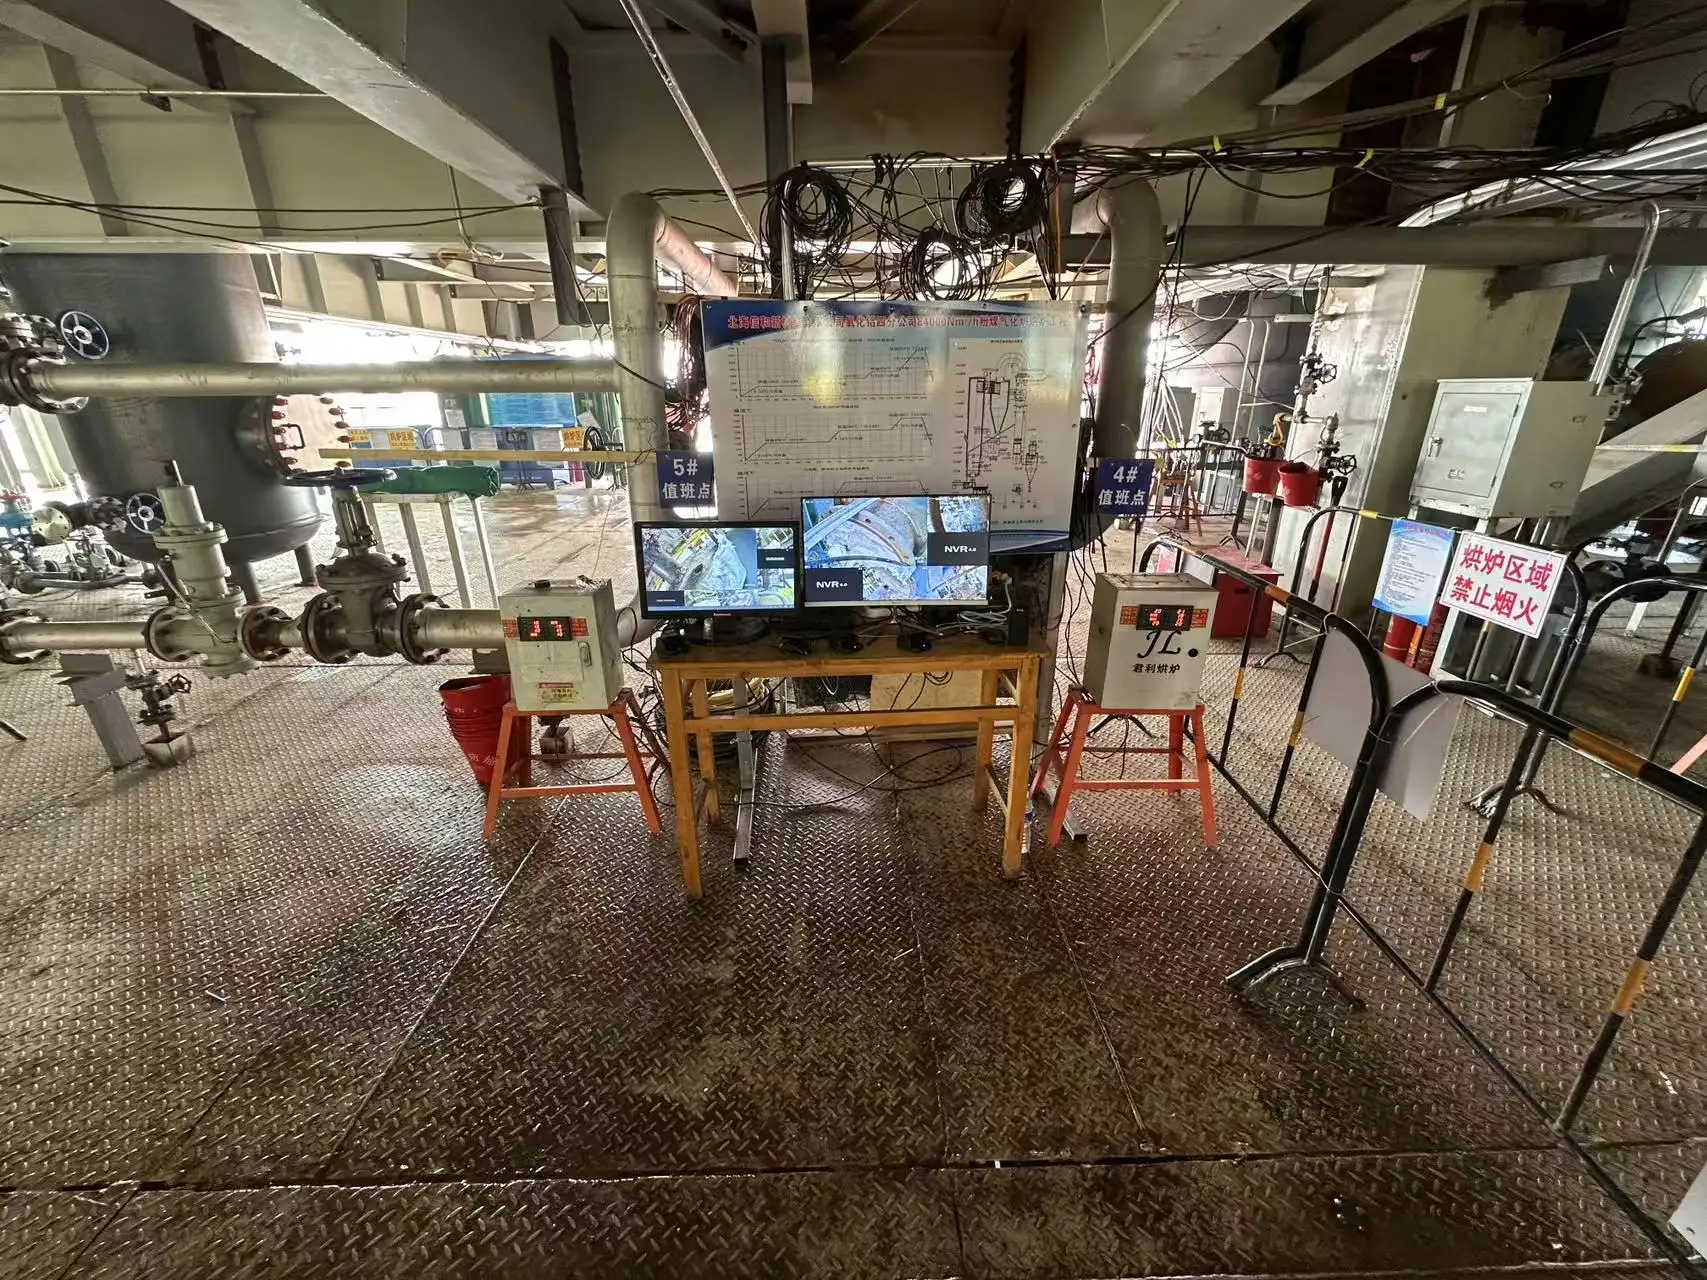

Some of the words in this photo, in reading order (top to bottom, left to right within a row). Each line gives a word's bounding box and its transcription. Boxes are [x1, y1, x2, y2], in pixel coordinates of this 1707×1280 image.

[673, 458, 698, 476] 5#
[1113, 466, 1138, 483] 4#
[662, 482, 710, 499] 值班点
[1098, 489, 1146, 506] 值班点
[1460, 543, 1553, 592] 烘炉区域
[1450, 574, 1538, 626] 禁止烟火
[1132, 663, 1181, 674] 君利烘炉
